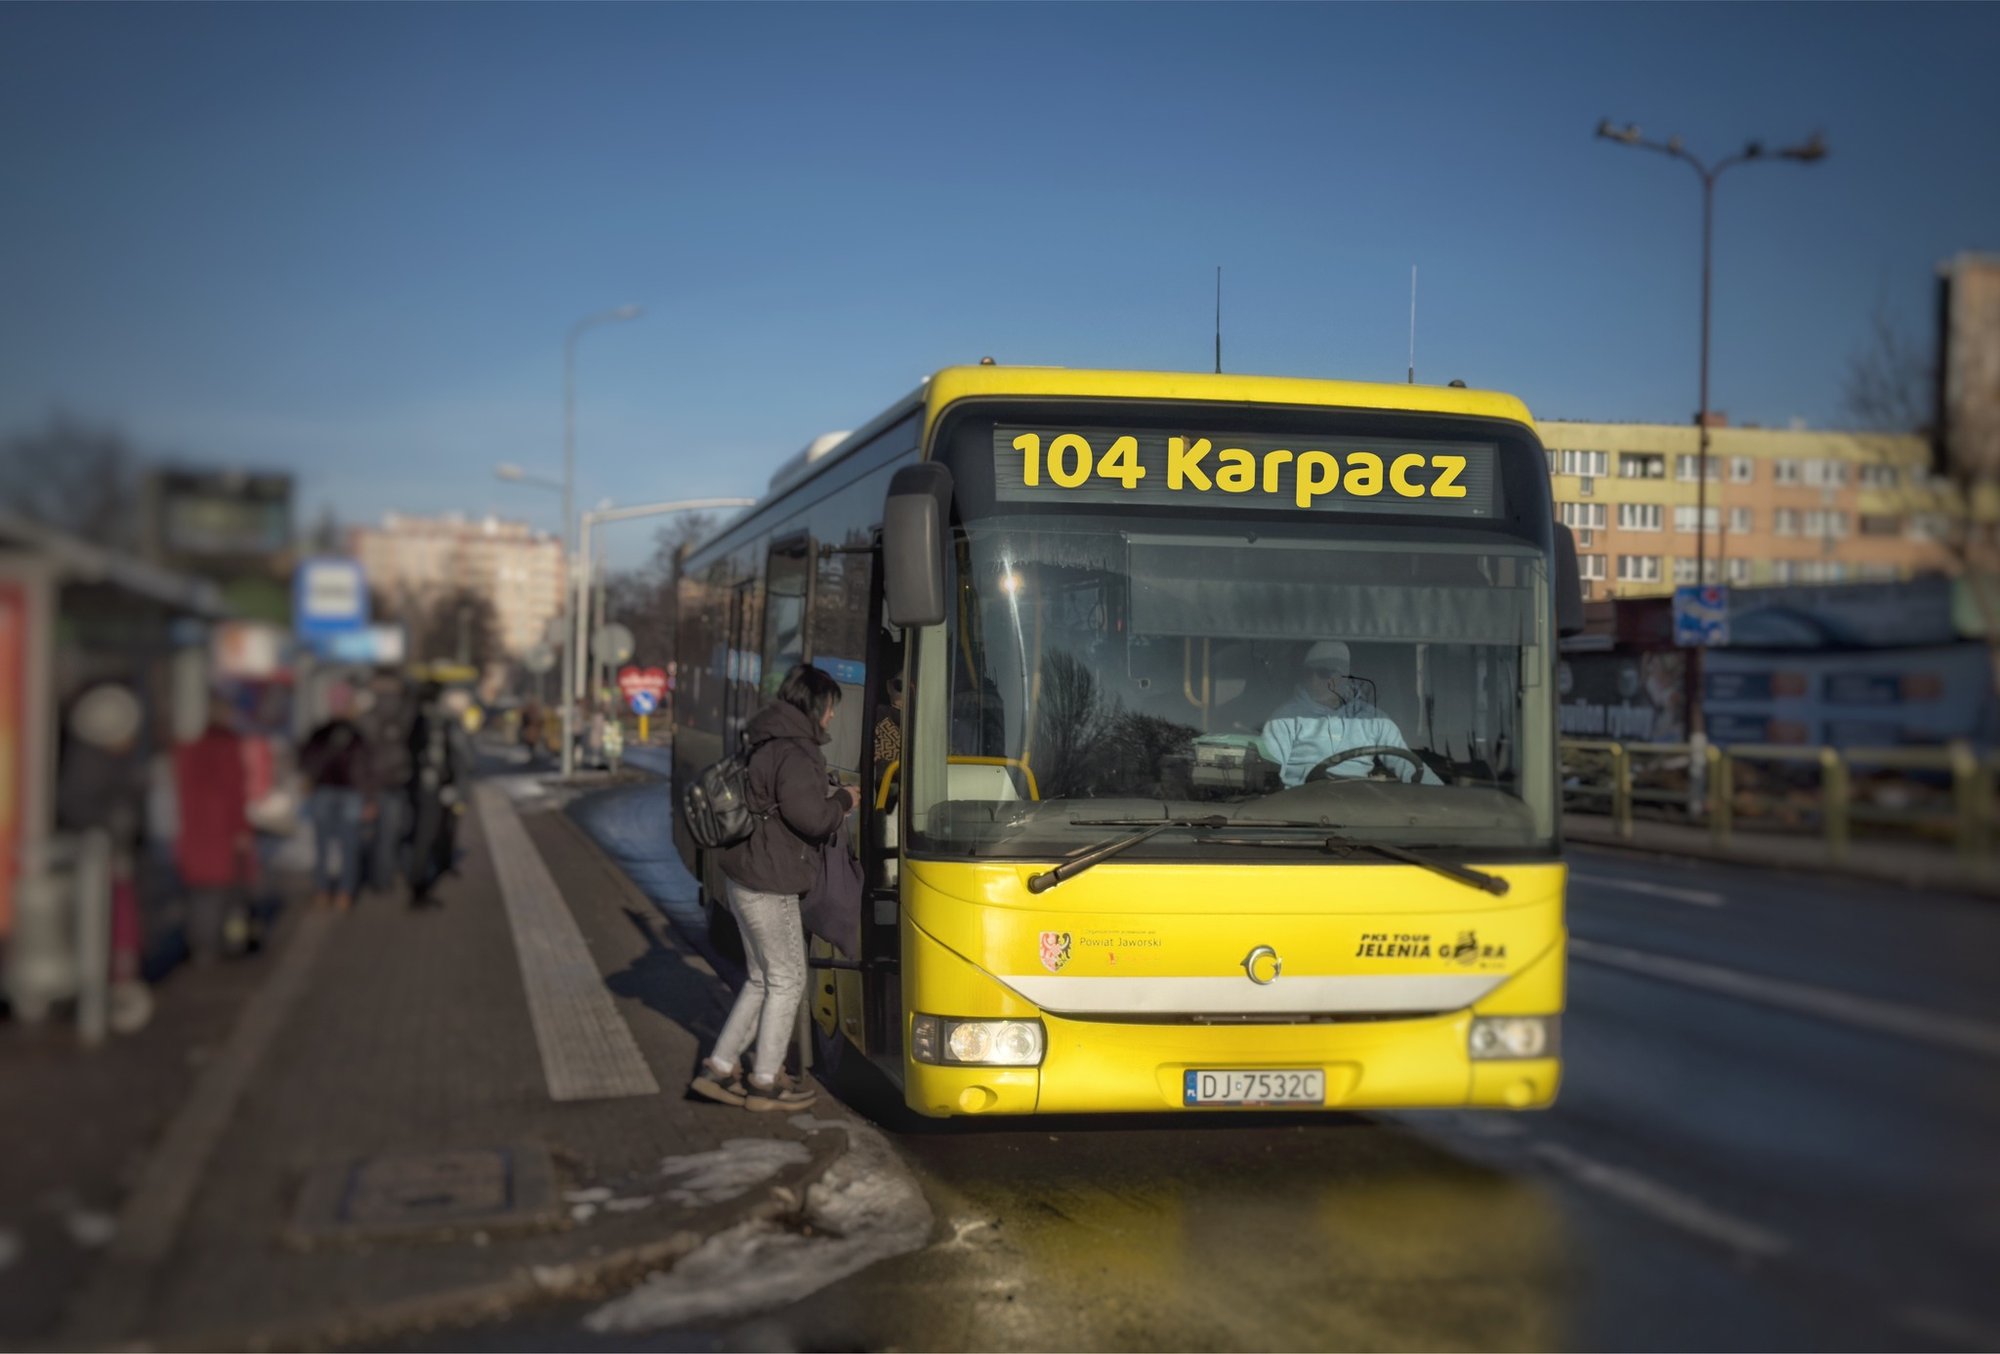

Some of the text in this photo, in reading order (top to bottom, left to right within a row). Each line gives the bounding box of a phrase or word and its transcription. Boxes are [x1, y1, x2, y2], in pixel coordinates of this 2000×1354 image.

[1012, 433, 1467, 508] 104 Karpacz
[1080, 937, 1162, 947] Powiat Jaworski
[1361, 933, 1431, 942] PKS TOUR
[1355, 943, 1431, 958] JELENIA
[1243, 1074, 1317, 1099] 7532C
